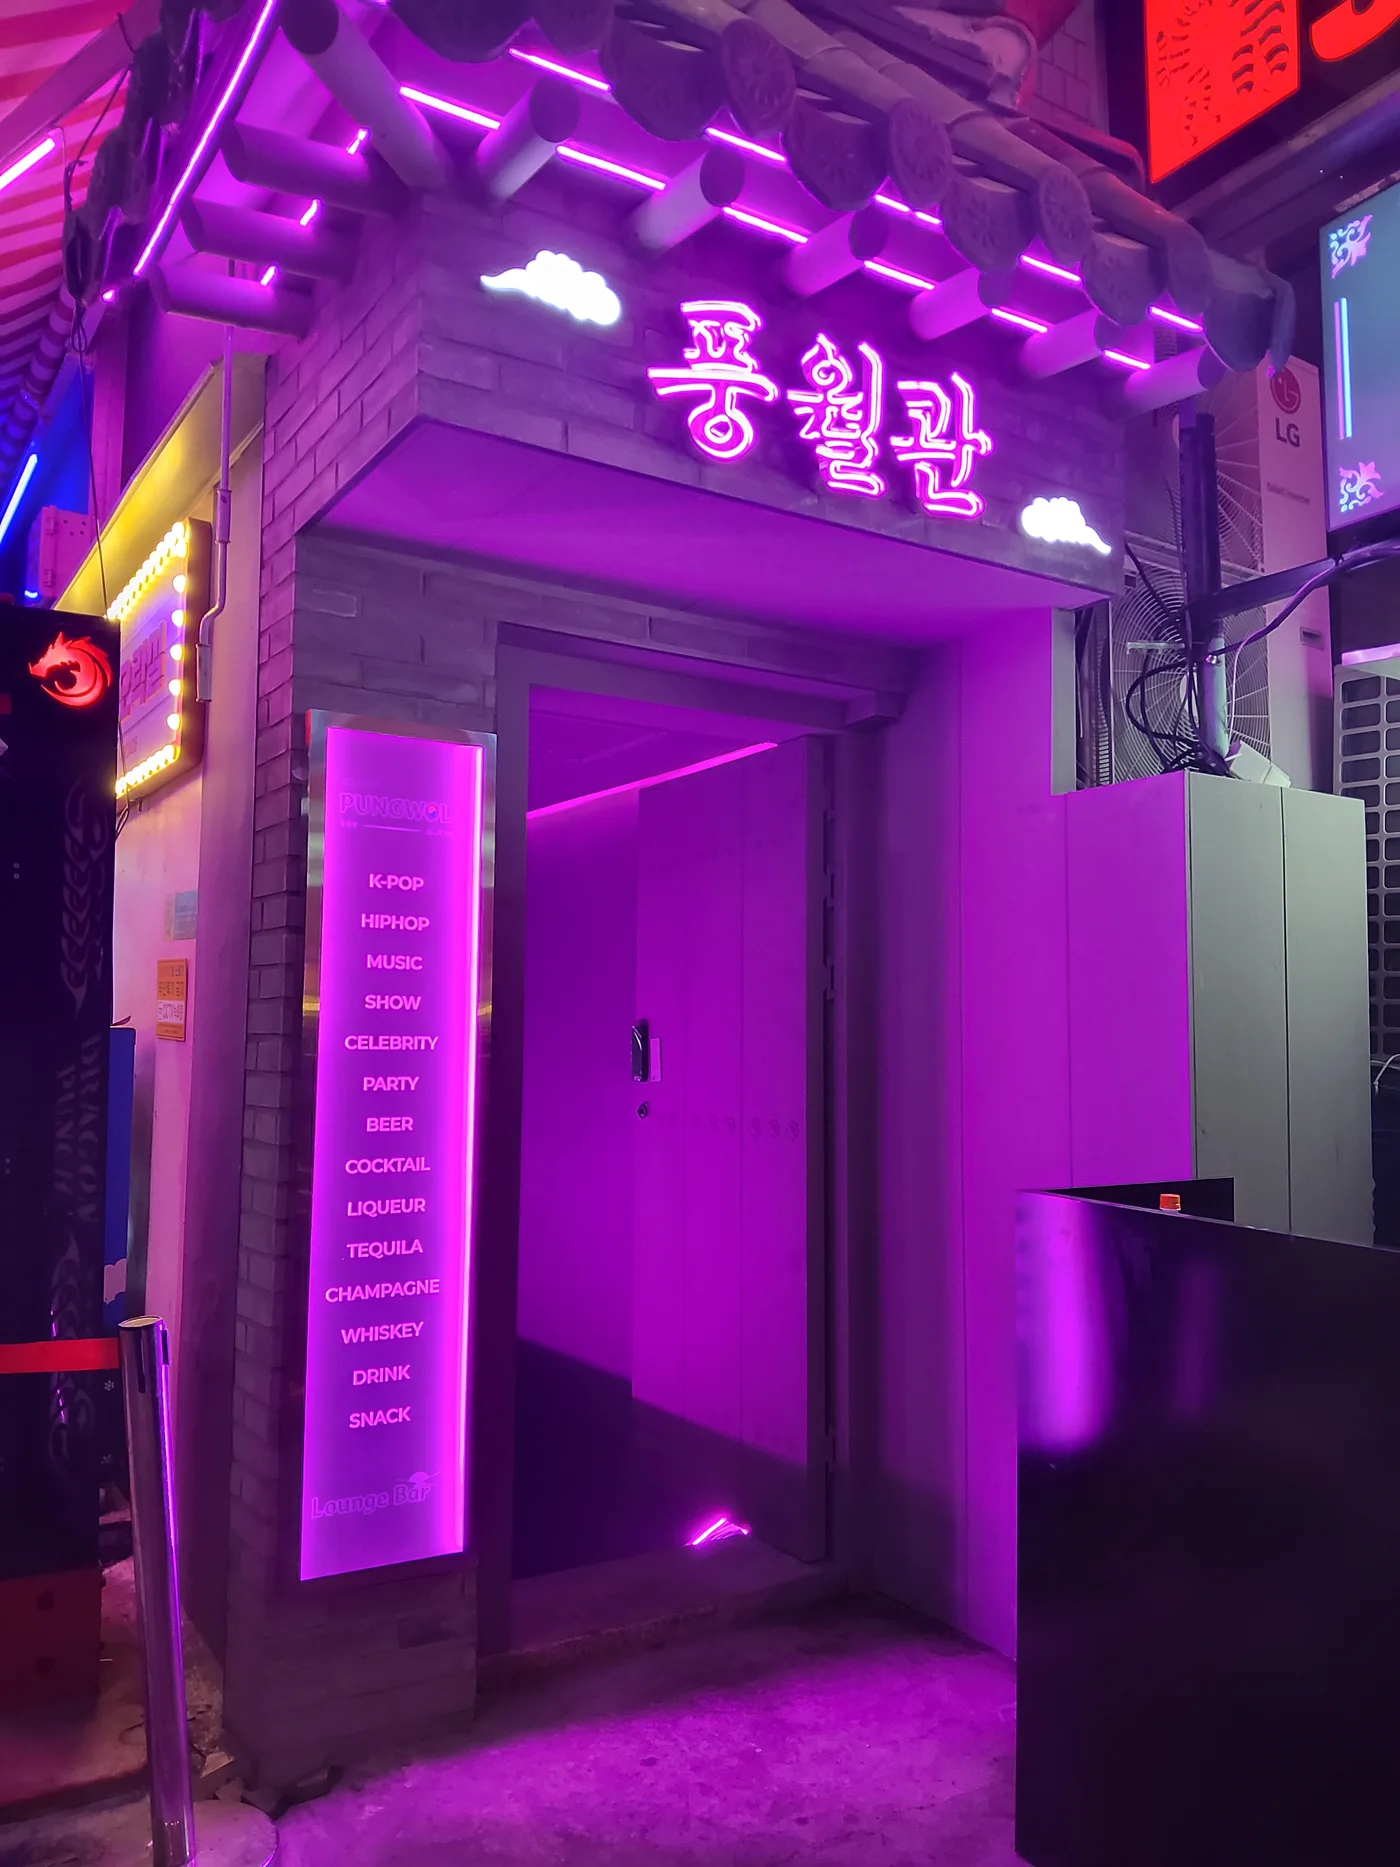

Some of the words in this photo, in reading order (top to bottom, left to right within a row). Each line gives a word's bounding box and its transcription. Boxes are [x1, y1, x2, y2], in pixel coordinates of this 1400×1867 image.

[646, 298, 994, 519] 풍월관
[1275, 417, 1301, 448] LG
[339, 792, 452, 824] PUNGWOL
[369, 873, 424, 891] K-POP
[361, 913, 430, 931] HIPHOP
[366, 954, 423, 970] MUSIC
[365, 994, 421, 1010] SHOW
[344, 1035, 439, 1051] CELEBRITY
[363, 1076, 419, 1091] PARTY
[366, 1117, 414, 1132] BEER
[345, 1157, 431, 1174] COCKTAIL
[347, 1198, 426, 1217] LIQUEUR
[346, 1239, 423, 1259] TEQUILA
[325, 1279, 440, 1303] CHAMPAGNE
[341, 1321, 424, 1344] WHISKEY
[353, 1364, 411, 1386] DRINK
[349, 1406, 411, 1429] SNACK
[311, 1492, 389, 1519] Lounge
[393, 1484, 431, 1506] Bar
